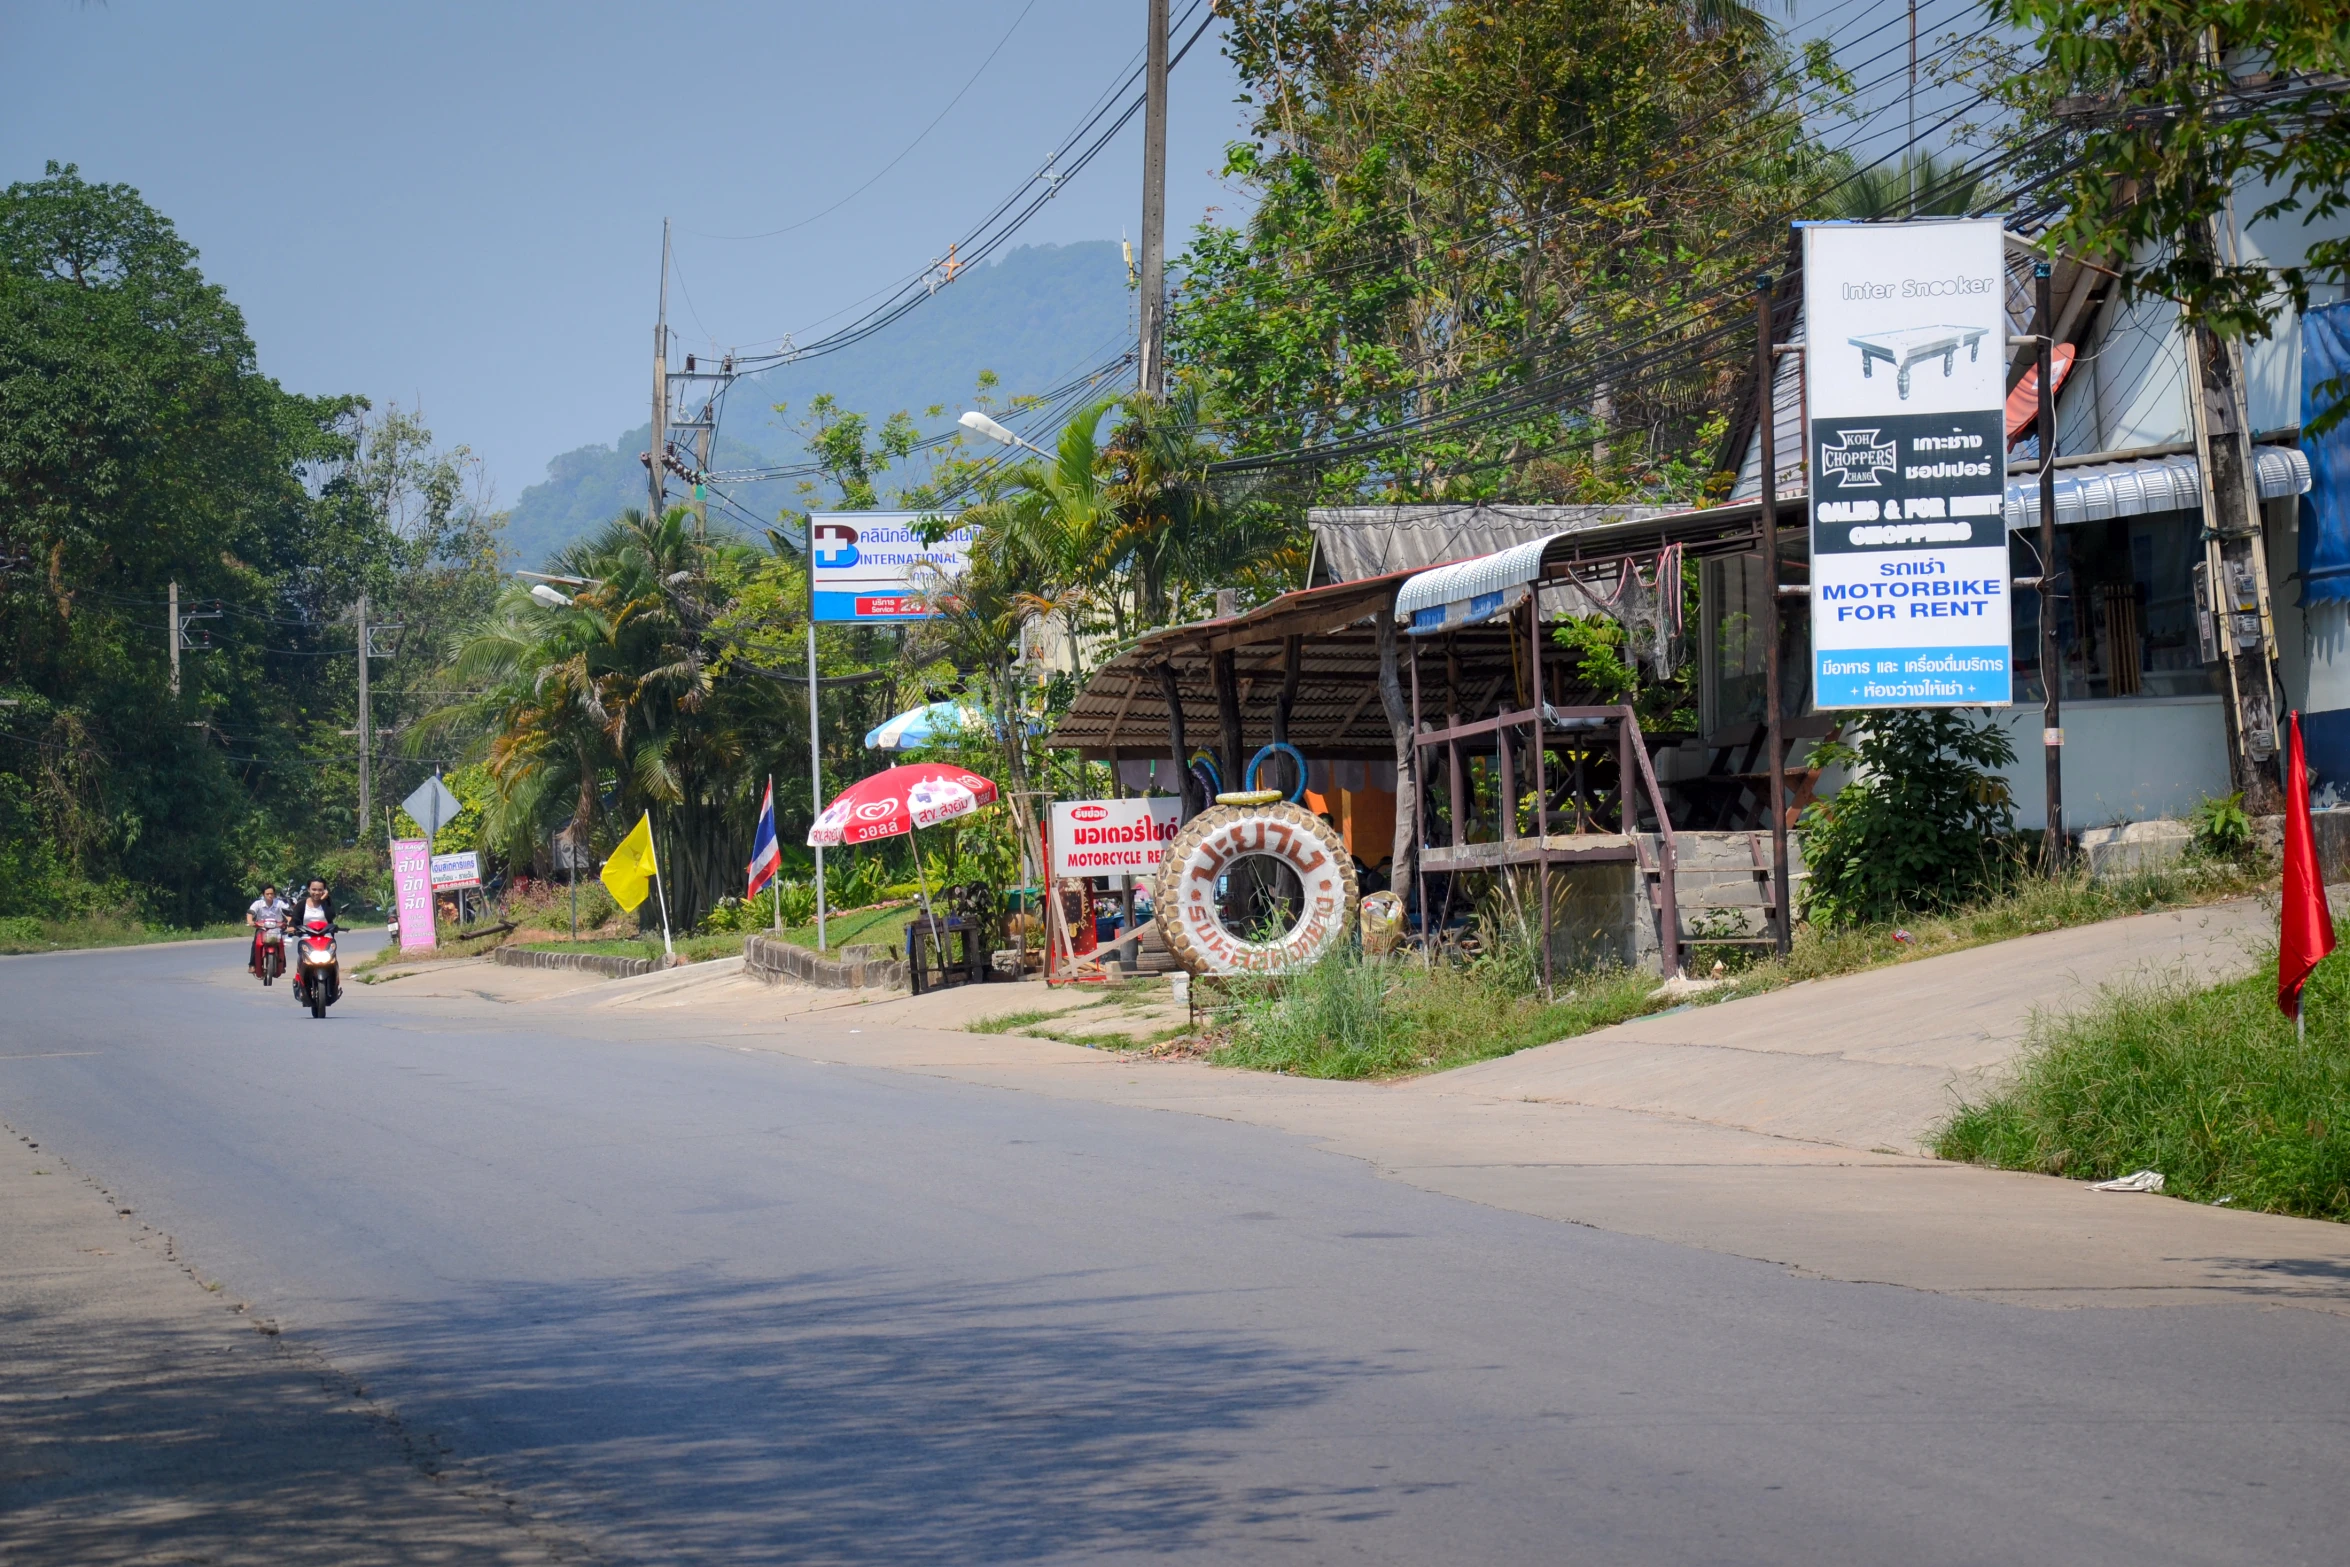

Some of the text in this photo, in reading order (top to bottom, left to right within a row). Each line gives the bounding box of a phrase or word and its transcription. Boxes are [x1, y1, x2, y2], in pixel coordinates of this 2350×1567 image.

[1843, 275, 1994, 300] Inter Snooker
[1847, 434, 1870, 446] KOH
[1913, 427, 1983, 451] เกาะช้าง
[1825, 449, 1894, 468] CHOPPERS
[1847, 471, 1873, 482] CHANG
[1884, 499, 1902, 520] &
[1904, 497, 1946, 519] FOR
[859, 553, 959, 565] INTERNATIONAL
[1880, 557, 1946, 577] รถเช่า
[1822, 579, 2001, 601] MOTORBIKE
[1838, 600, 1988, 621] FOR RENT
[1822, 653, 2004, 676] มีอาหาร และ เครื่องดื่มบริการ
[1864, 678, 1963, 698] ห้องว่างให้เช่า
[1075, 806, 1107, 819] รับซ่อม
[858, 817, 899, 839] วอลล์
[1068, 851, 1141, 867] MOTORCYCLE
[1191, 822, 1326, 882] ปะยาง
[398, 856, 425, 873] ล้าง
[403, 875, 424, 892] อัด
